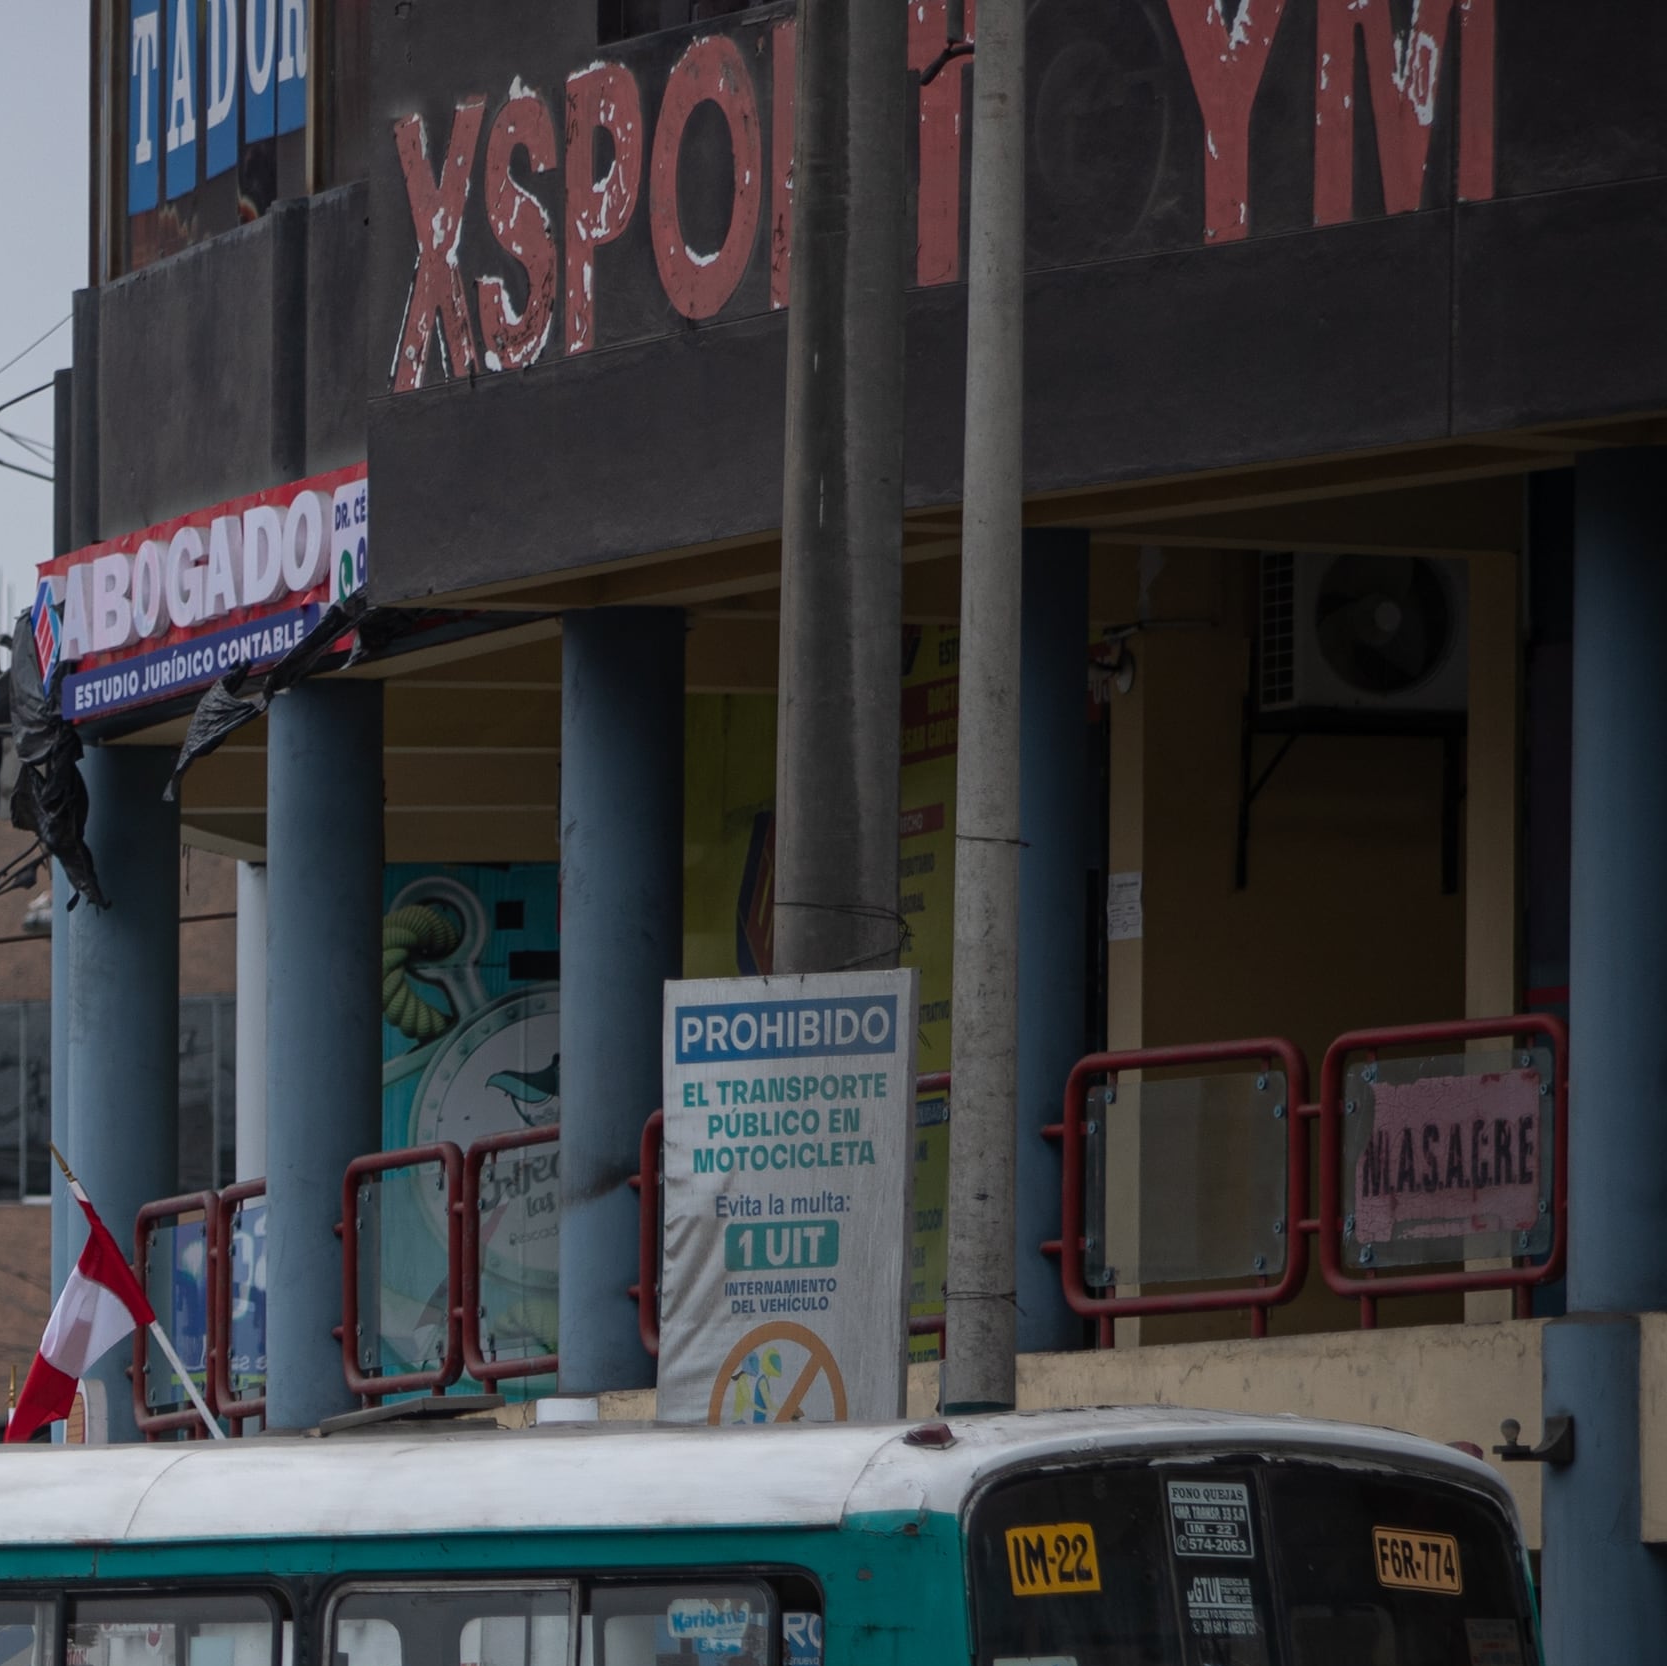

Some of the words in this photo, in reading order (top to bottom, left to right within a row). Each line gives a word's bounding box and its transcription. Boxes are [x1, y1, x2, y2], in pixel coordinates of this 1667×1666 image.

[59, 489, 335, 662] ABOGADO
[74, 673, 140, 712] ESTUDIO
[141, 649, 215, 693] JURÍDICO
[217, 618, 306, 669] CONTABLE
[680, 1004, 891, 1054] PROHIBIDO
[683, 1081, 709, 1108] EL
[716, 1072, 888, 1105] TRANSPORTE
[708, 1106, 820, 1140] PÚBLICO
[829, 1107, 860, 1133] EN
[693, 1140, 876, 1174] MOTOCICLETA
[715, 1194, 762, 1219] Evita
[769, 1192, 784, 1216] la
[789, 1190, 852, 1216] multa:
[738, 1228, 752, 1267] 1
[767, 1226, 827, 1266] UIT
[724, 1278, 838, 1297] INTERNAMIENTO
[731, 1298, 760, 1315] DEL
[765, 1291, 830, 1314] VEHÍCULO
[1171, 1487, 1200, 1500] FONO
[1203, 1488, 1244, 1501] QUEJAS
[1012, 1534, 1093, 1587] IM-22
